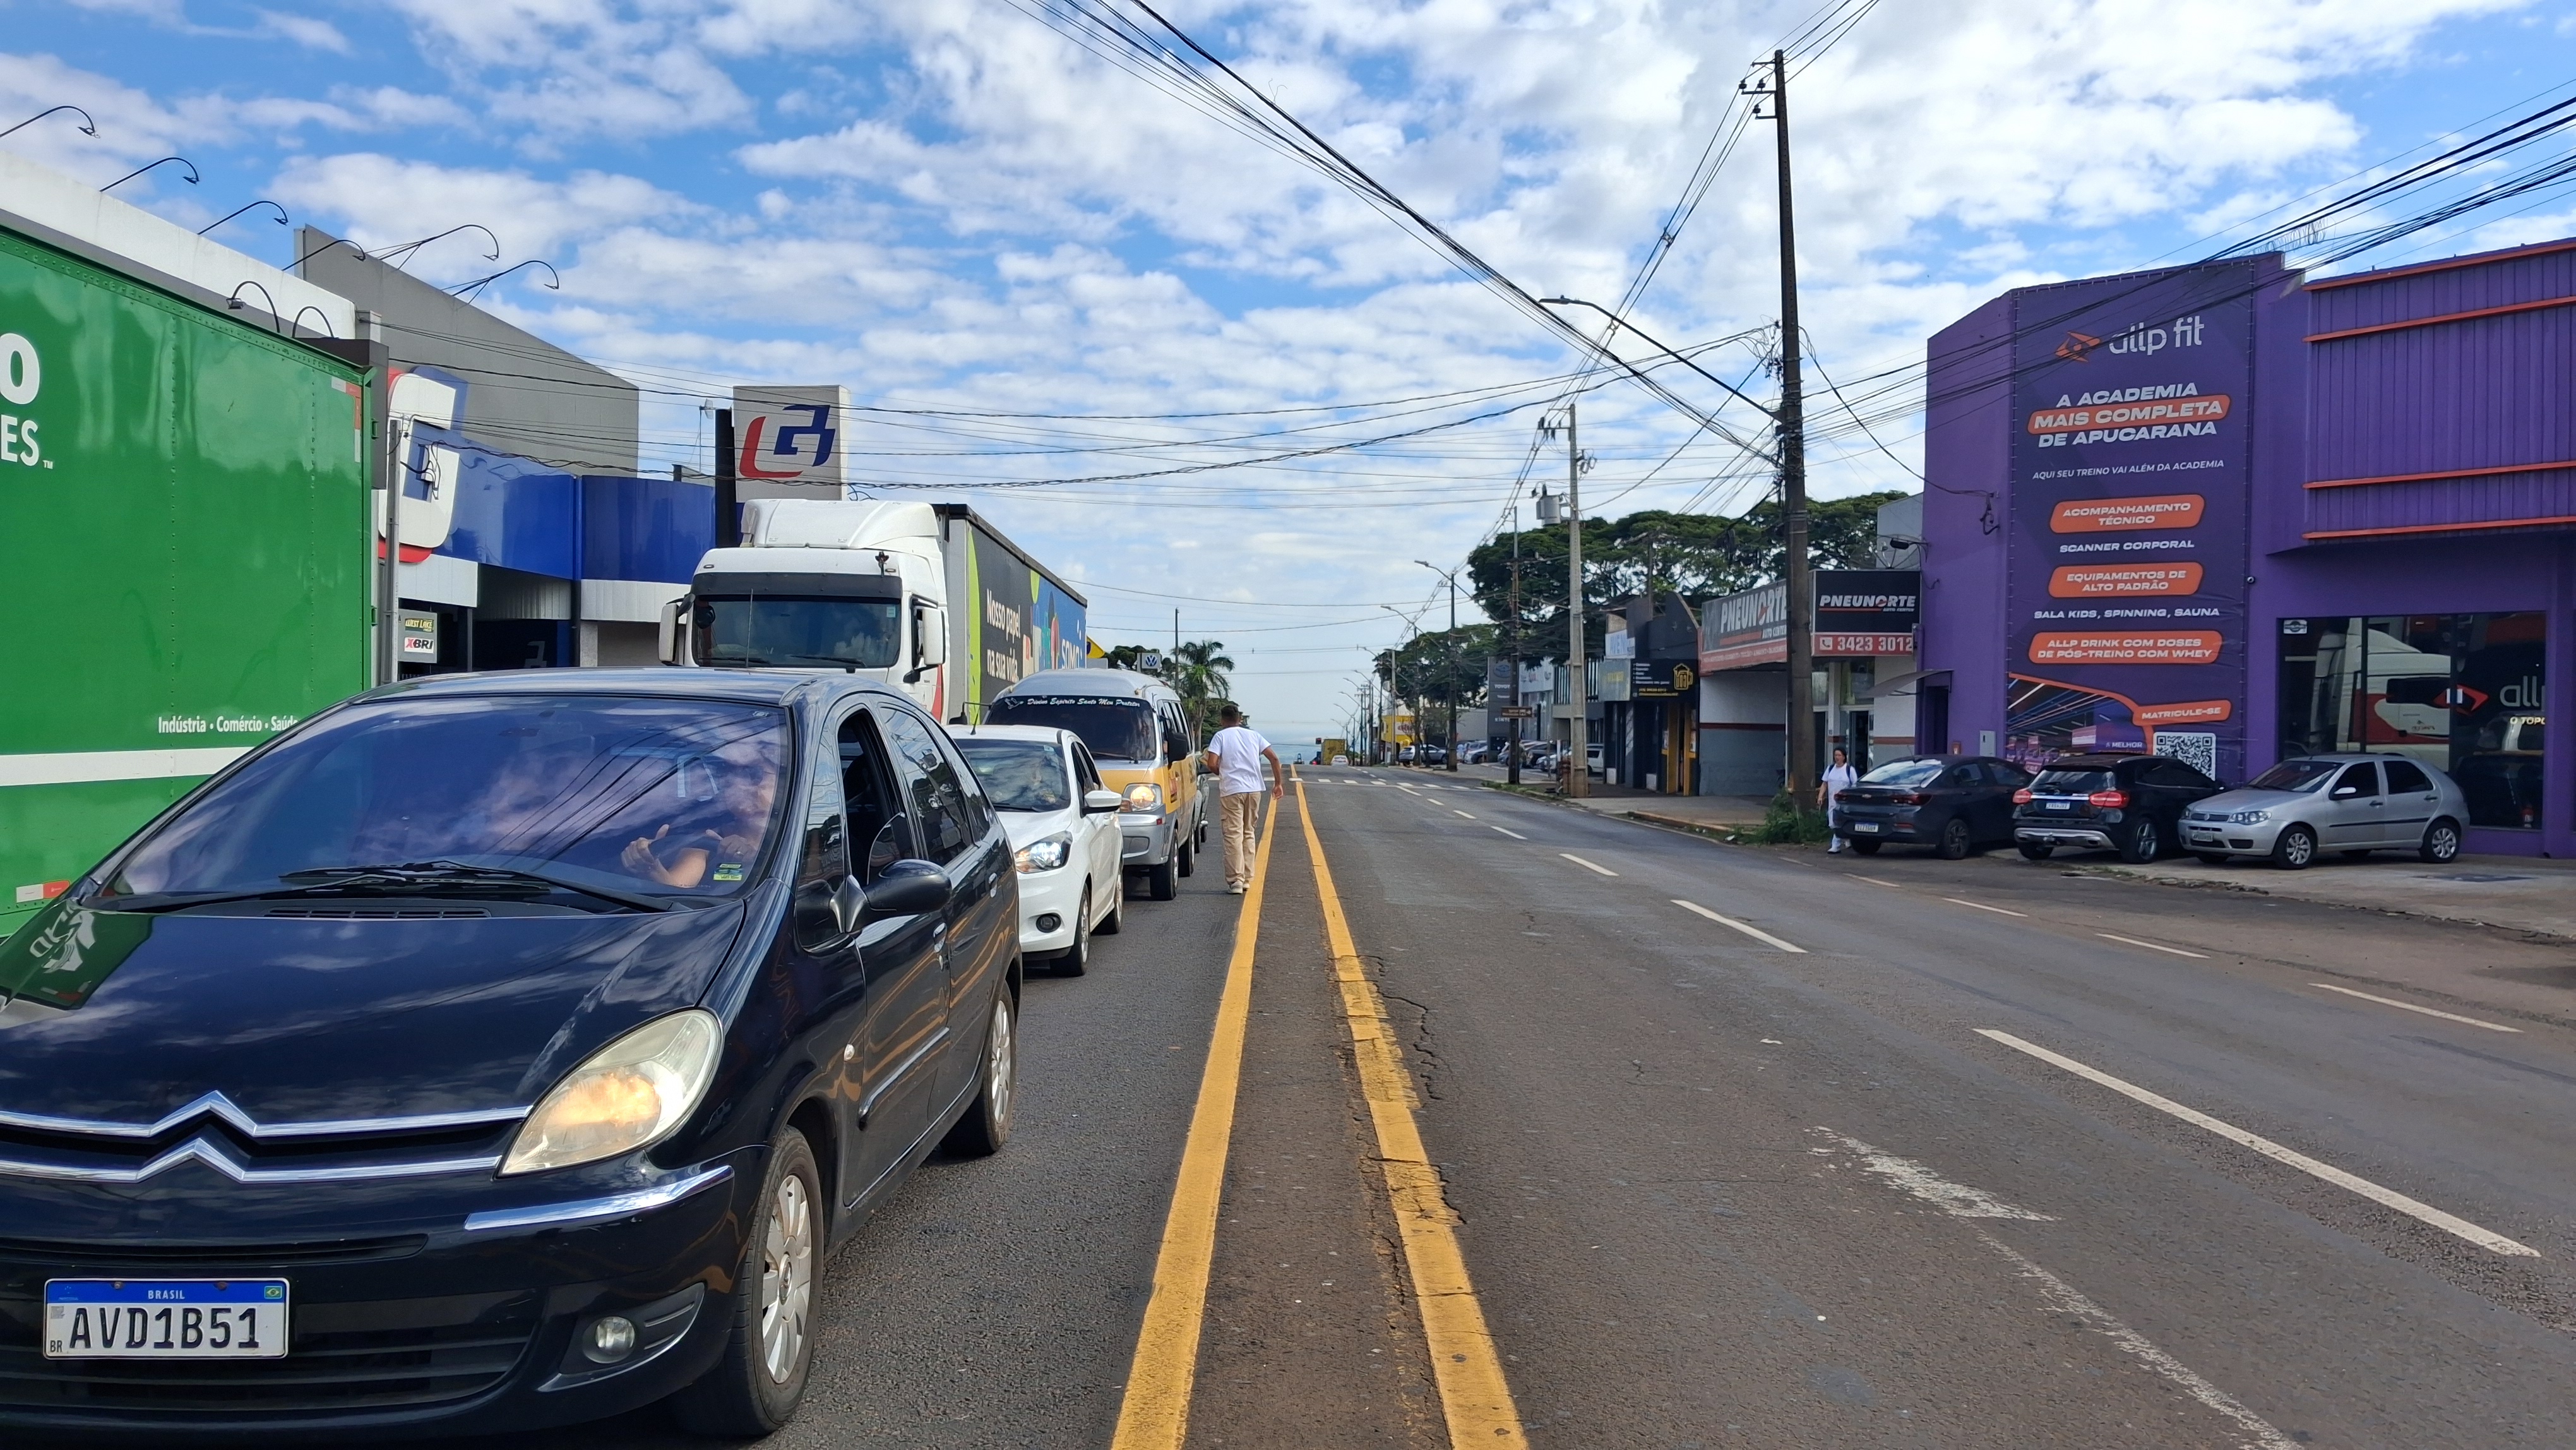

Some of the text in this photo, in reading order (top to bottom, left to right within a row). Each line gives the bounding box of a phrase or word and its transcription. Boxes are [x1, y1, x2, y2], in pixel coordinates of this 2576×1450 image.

[2109, 315, 2204, 355] allp fit
[2056, 382, 2198, 408] A ACADEMIA
[2034, 400, 2222, 429] MAIS COMPLETA
[2039, 421, 2217, 448] DE APUCARANA
[2032, 460, 2224, 480] AQUI SEU TREINO VAI ALÉM DA ACADEMIA
[2063, 503, 2191, 517] ACOMPANHAMENTO
[2099, 515, 2156, 525] TÉCNICO
[2060, 540, 2195, 553] SCANNER CORPORAL
[2066, 570, 2186, 583] EQUIPAMENTOS DE
[2082, 580, 2169, 592] ALTO PADRÃO
[1820, 595, 1916, 607] PNEUNORTE
[1720, 585, 1786, 633] PNEUNORTE
[2034, 608, 2220, 620] SALA KIDS, SPINNING, SAUNA
[987, 589, 1021, 644] Nosso papel
[406, 638, 433, 649] XBRI
[1837, 637, 1912, 652] 3423 3012
[2157, 638, 2202, 647] DOSES
[2056, 648, 2134, 658] PÓS-TREINO
[2137, 650, 2168, 658] COM
[2172, 649, 2212, 658] WHEY
[987, 649, 994, 675] na
[996, 652, 1006, 680] sua
[2142, 707, 2221, 719] MATRICULE-SE
[2510, 716, 2518, 724] O
[158, 716, 206, 733] Indústria
[217, 715, 262, 731] Comércio
[148, 1290, 185, 1300] BRASIL
[69, 1307, 259, 1349] AVD1B51
[50, 1339, 63, 1353] BR
